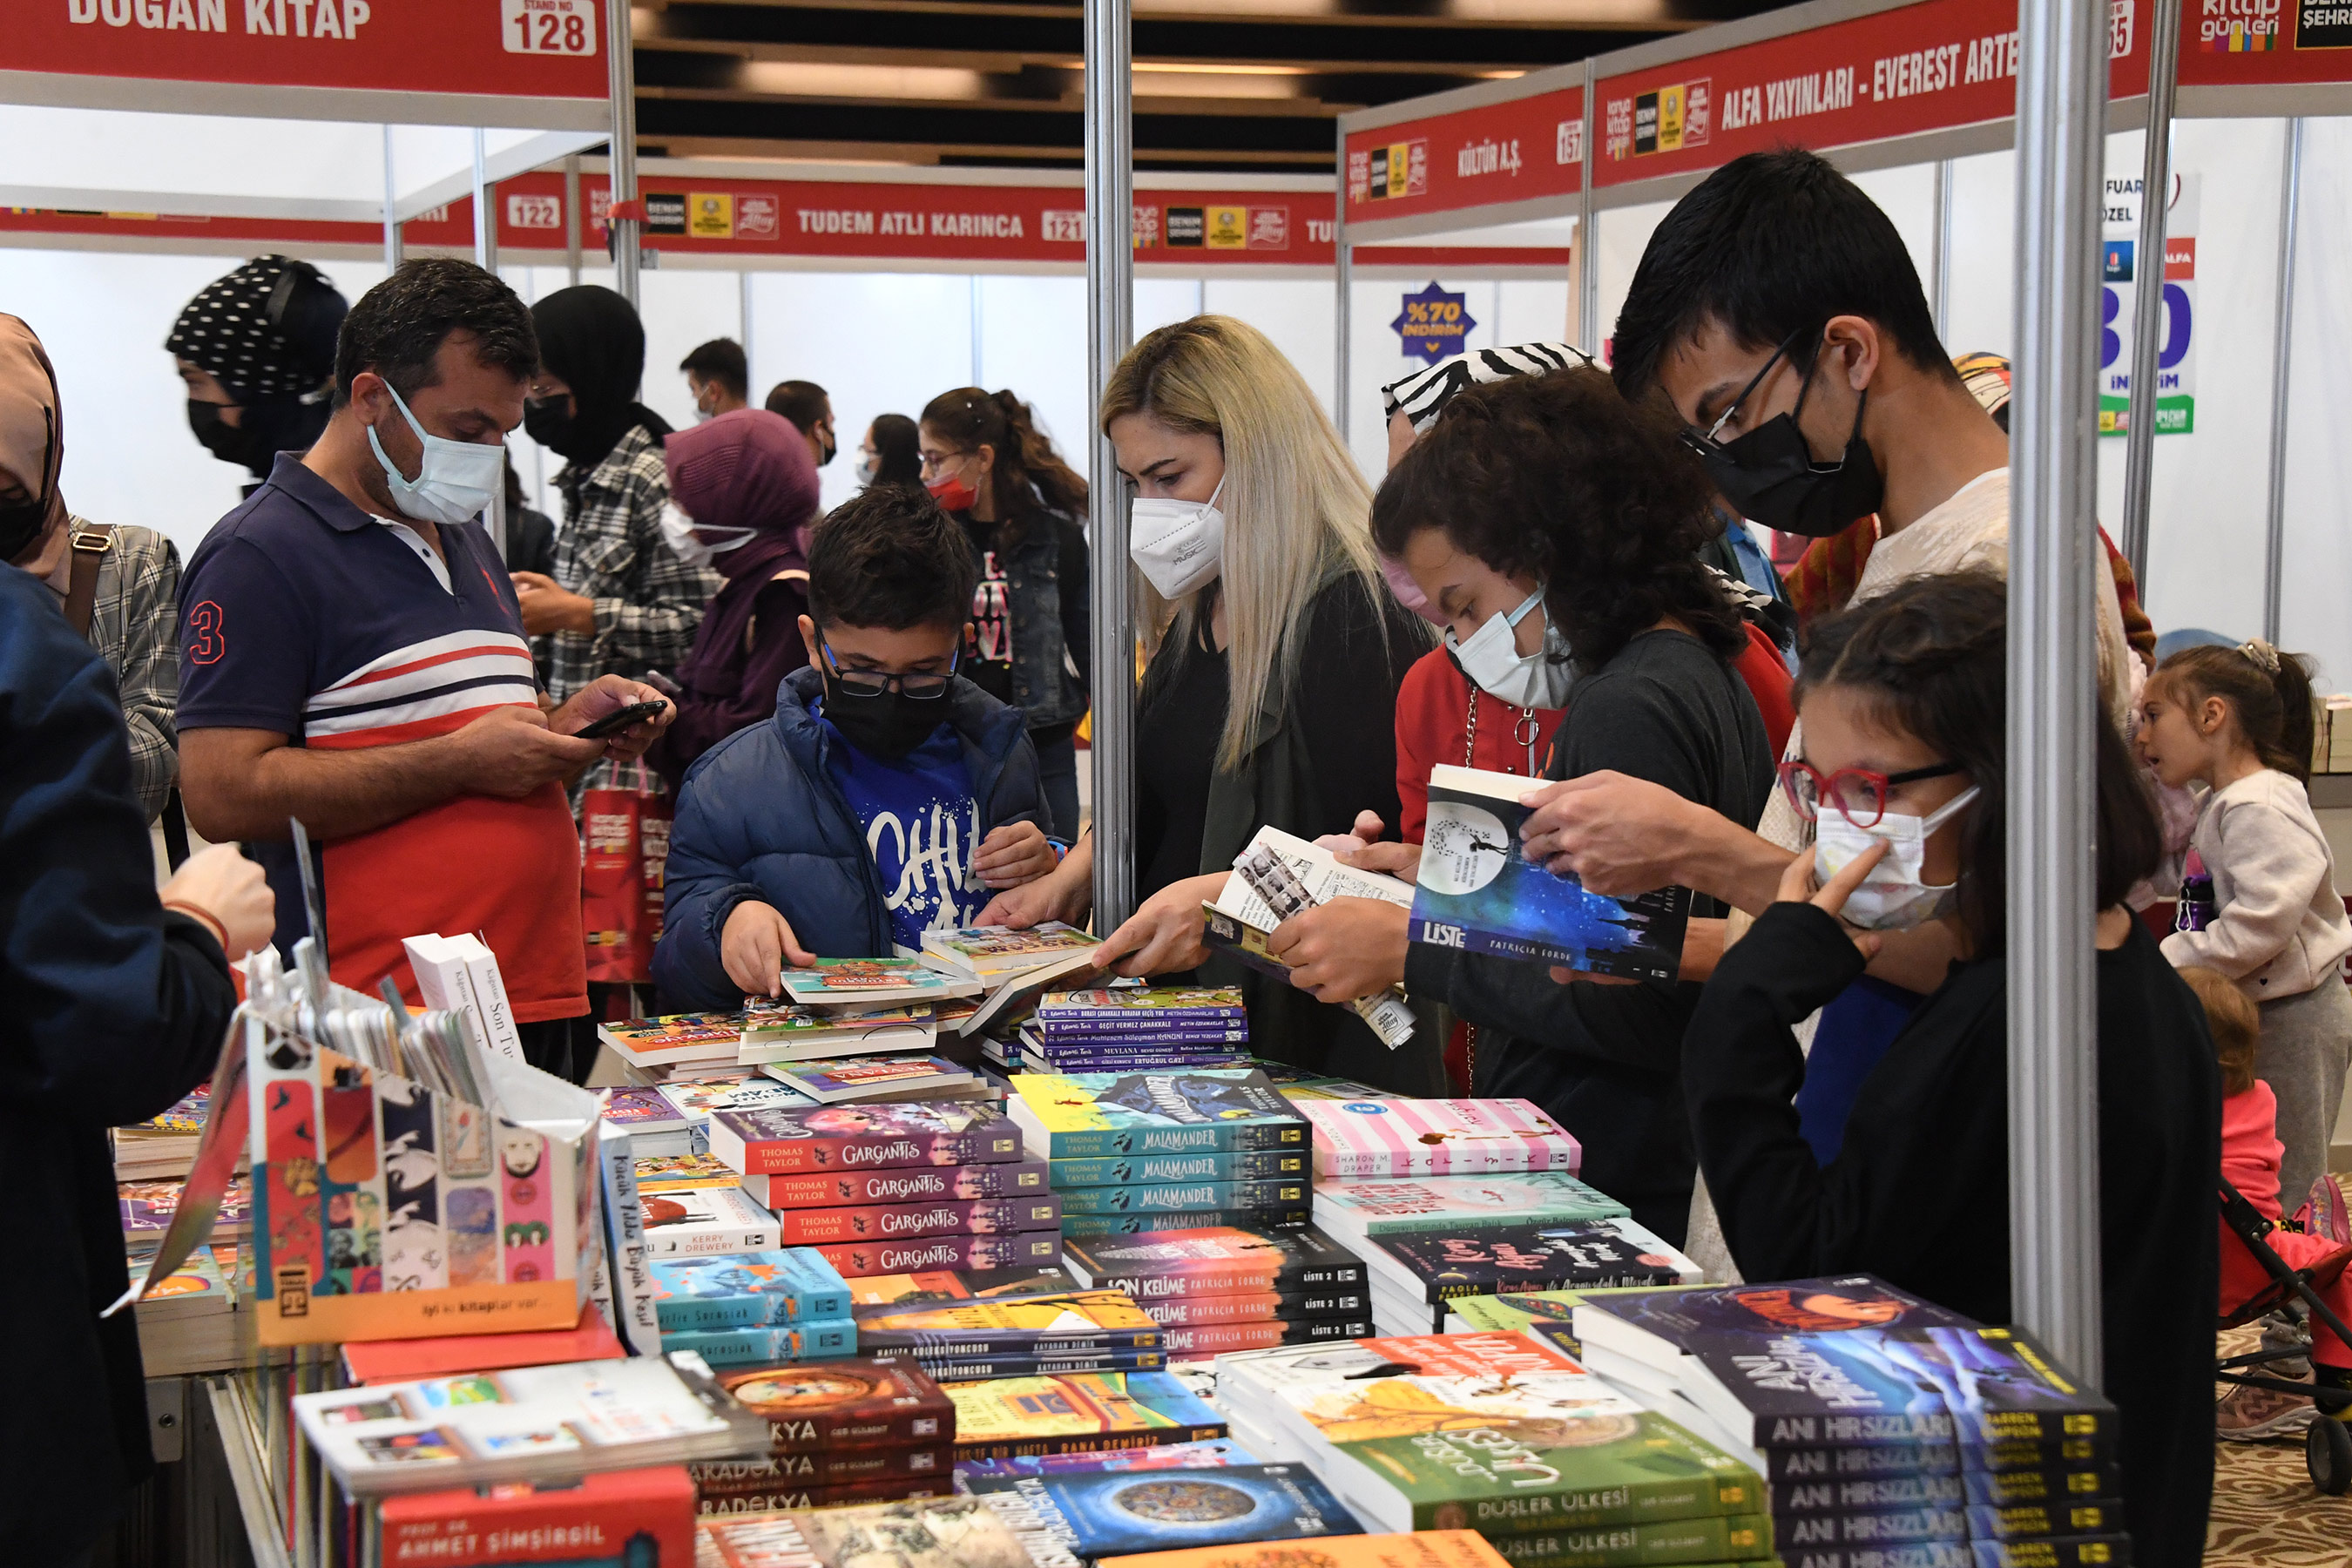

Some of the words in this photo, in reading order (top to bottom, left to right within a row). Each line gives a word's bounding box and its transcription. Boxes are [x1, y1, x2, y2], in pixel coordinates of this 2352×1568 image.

[513, 13, 586, 52] 128
[2200, 16, 2280, 42] günleri
[1722, 85, 1762, 131] ALFA
[1766, 65, 1855, 122] YAYINLARI
[1873, 44, 1961, 103] EVEREST
[1458, 138, 1498, 177] KÜLTÜR
[515, 206, 555, 227] 122
[797, 209, 874, 234] TUDEM
[880, 212, 925, 236] ATLI
[930, 213, 1024, 239] KARINCA
[1049, 220, 1082, 238] 121
[1407, 301, 1461, 322] %70
[189, 600, 226, 666] 3
[1423, 921, 1467, 949] LİSTE
[1490, 939, 1537, 956] PATRICIA
[1541, 949, 1571, 962] FORDE
[1098, 1009, 1121, 1018] ÇANAKKALE
[490, 1002, 505, 1031] Son
[500, 1031, 515, 1058] Tu
[1098, 1023, 1114, 1031] GEÇİT
[1139, 1021, 1172, 1030] ÇANAKKALE
[1124, 1033, 1156, 1042] Süleyman
[1064, 1135, 1103, 1144] THOMAS
[1141, 1128, 1219, 1151] MALAMANDER
[760, 1147, 803, 1157] THOMAS
[762, 1158, 801, 1167] TAYLOR
[842, 1140, 921, 1166] GARGANTIS
[1335, 1153, 1375, 1164] SHARON
[1064, 1165, 1102, 1173] THOMAS
[1140, 1158, 1219, 1180] MALAMANDER
[1344, 1164, 1382, 1173] DRAPER
[785, 1180, 828, 1191] THOMAS
[787, 1191, 826, 1201] TAYLOR
[867, 1173, 945, 1199] GARGANTIS
[1062, 1193, 1100, 1201] THOMAS
[1139, 1186, 1217, 1208] MALAMANDER
[800, 1215, 842, 1226] THOMAS
[801, 1226, 841, 1236] TAYLOR
[881, 1208, 959, 1233] GARGANTIS
[1073, 1220, 1111, 1229] THOMAS
[686, 1242, 733, 1254] DREWERY
[693, 1233, 723, 1245] KERRY
[881, 1245, 959, 1269] GARGANTIS
[1143, 1273, 1186, 1296] KELİME
[1191, 1278, 1233, 1289] PATRICIA
[1238, 1274, 1266, 1287] FORDE
[1303, 1270, 1324, 1282] LİSTE
[1327, 1272, 1333, 1281] 2
[1442, 1284, 1480, 1294] PAOLA
[1145, 1301, 1187, 1324] KELİME
[1192, 1307, 1234, 1318] PATRICIA
[1240, 1302, 1267, 1315] FORDE
[1305, 1297, 1327, 1308] LİSTE
[1328, 1298, 1335, 1308] 2
[1199, 1333, 1242, 1344] PATRICIA
[1247, 1329, 1274, 1341] FORDE
[1311, 1323, 1333, 1335] LİSTE
[1335, 1325, 1341, 1335] 2
[1772, 1418, 1815, 1442] ANI
[1825, 1414, 1952, 1441] HIRSIZLARI
[1061, 1440, 1099, 1455] RANA
[1102, 1434, 1160, 1451] DEMİRİZ
[1786, 1452, 1828, 1476] ANI
[1790, 1484, 1830, 1510] ANI
[1793, 1519, 1835, 1544] ANI
[398, 1534, 479, 1559] AHMET
